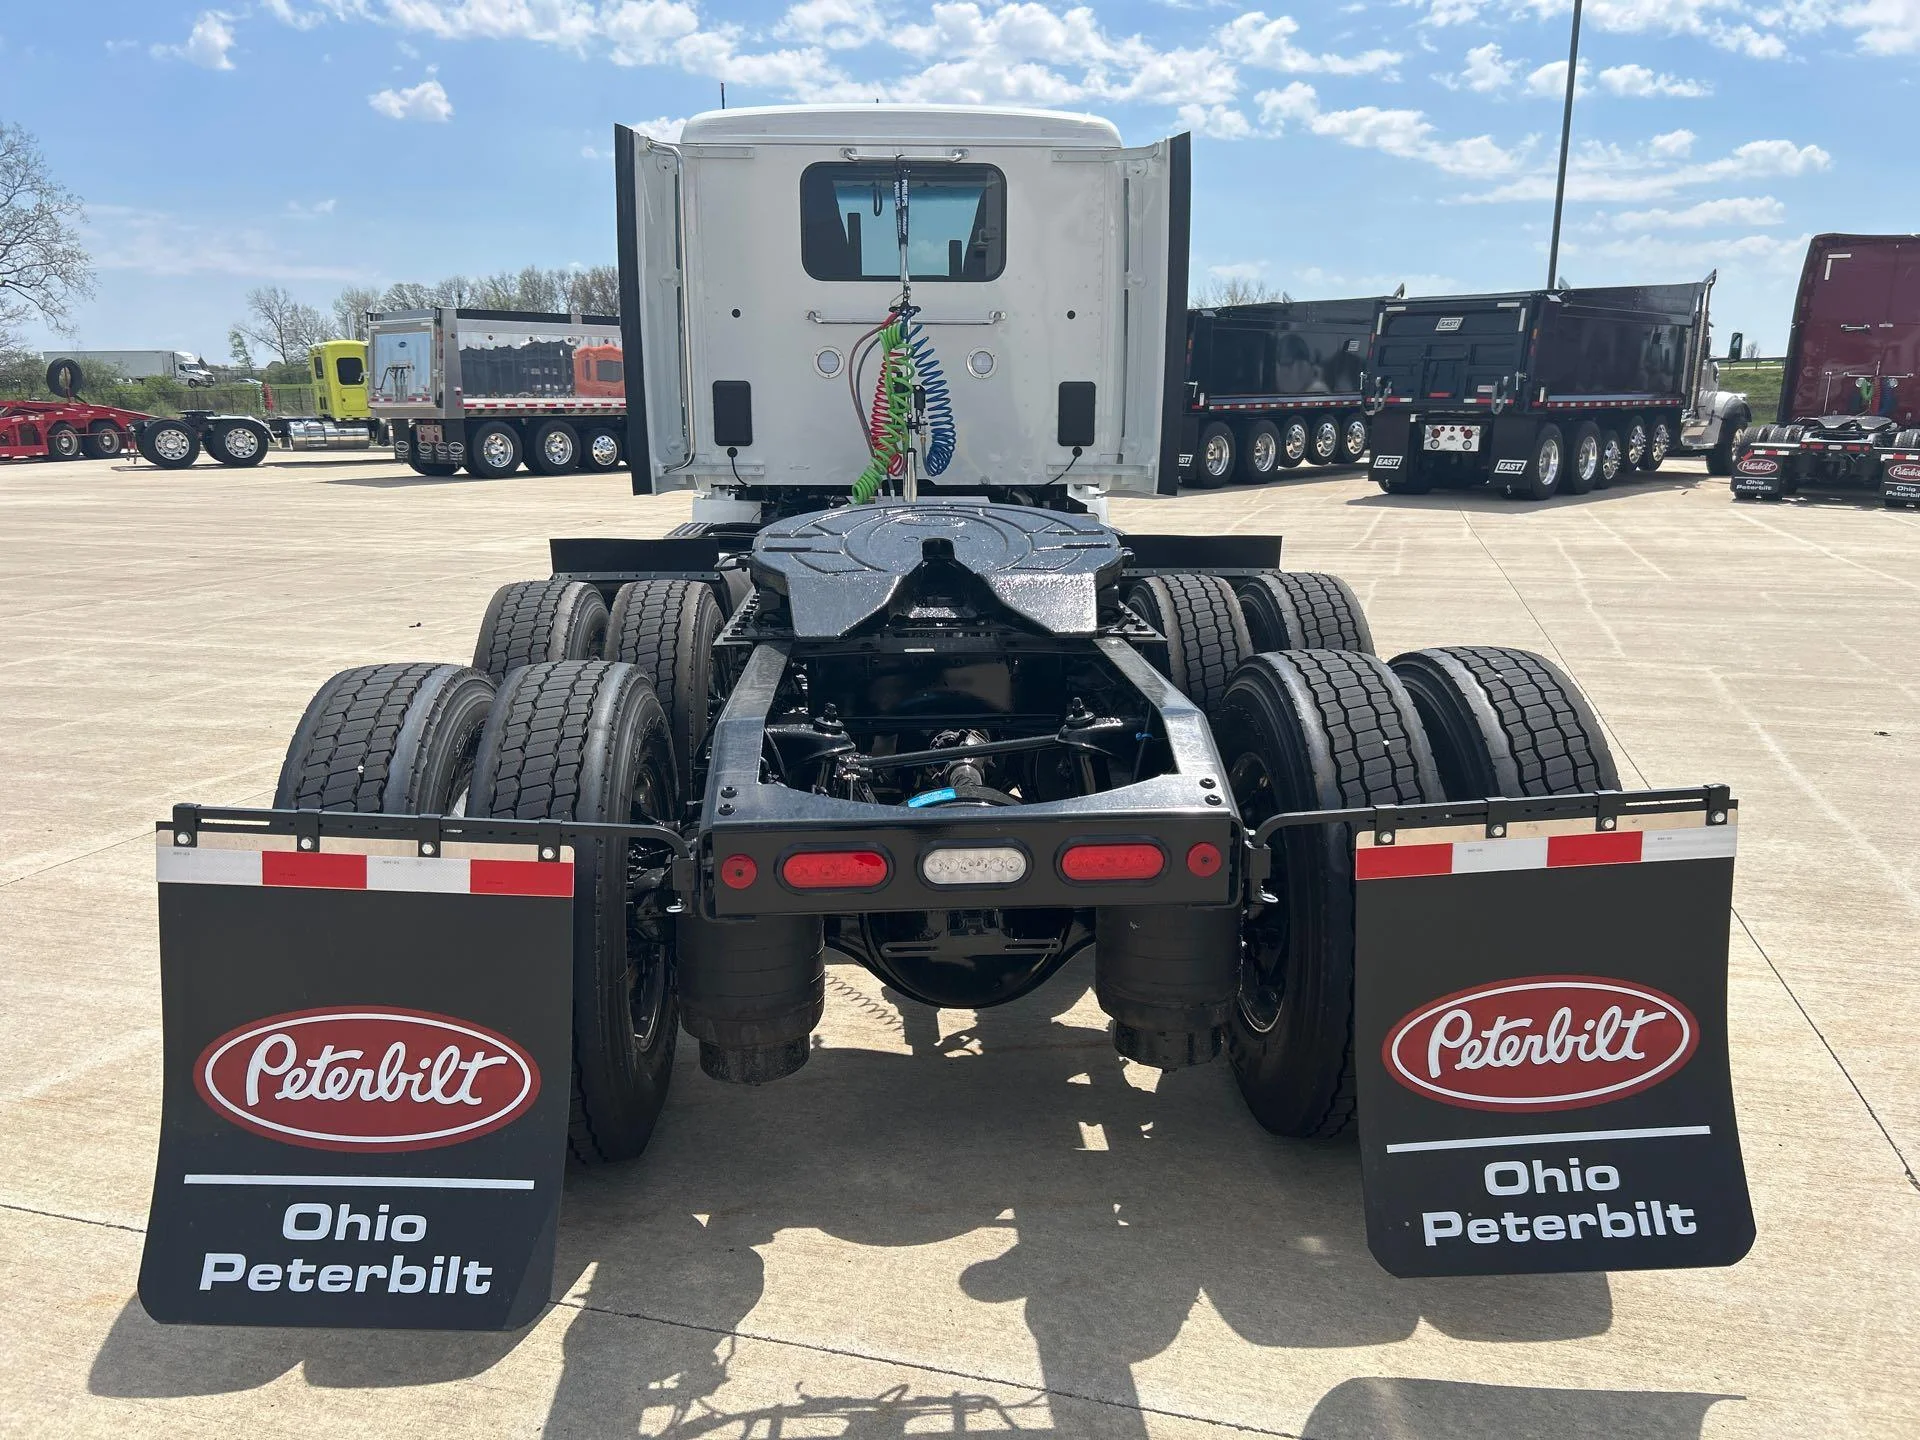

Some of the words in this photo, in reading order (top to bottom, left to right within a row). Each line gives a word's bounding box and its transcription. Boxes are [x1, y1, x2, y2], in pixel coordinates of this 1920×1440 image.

[1377, 458, 1399, 466] EAST
[1498, 462, 1522, 471] EAST
[1427, 1005, 1667, 1079] Peterbilt
[245, 1033, 508, 1107] Peterbilt
[1484, 1157, 1620, 1196] Ohio
[282, 1202, 428, 1242] Ohio
[1421, 1200, 1697, 1247] Peterbilt
[199, 1252, 494, 1295] Peterbilt
